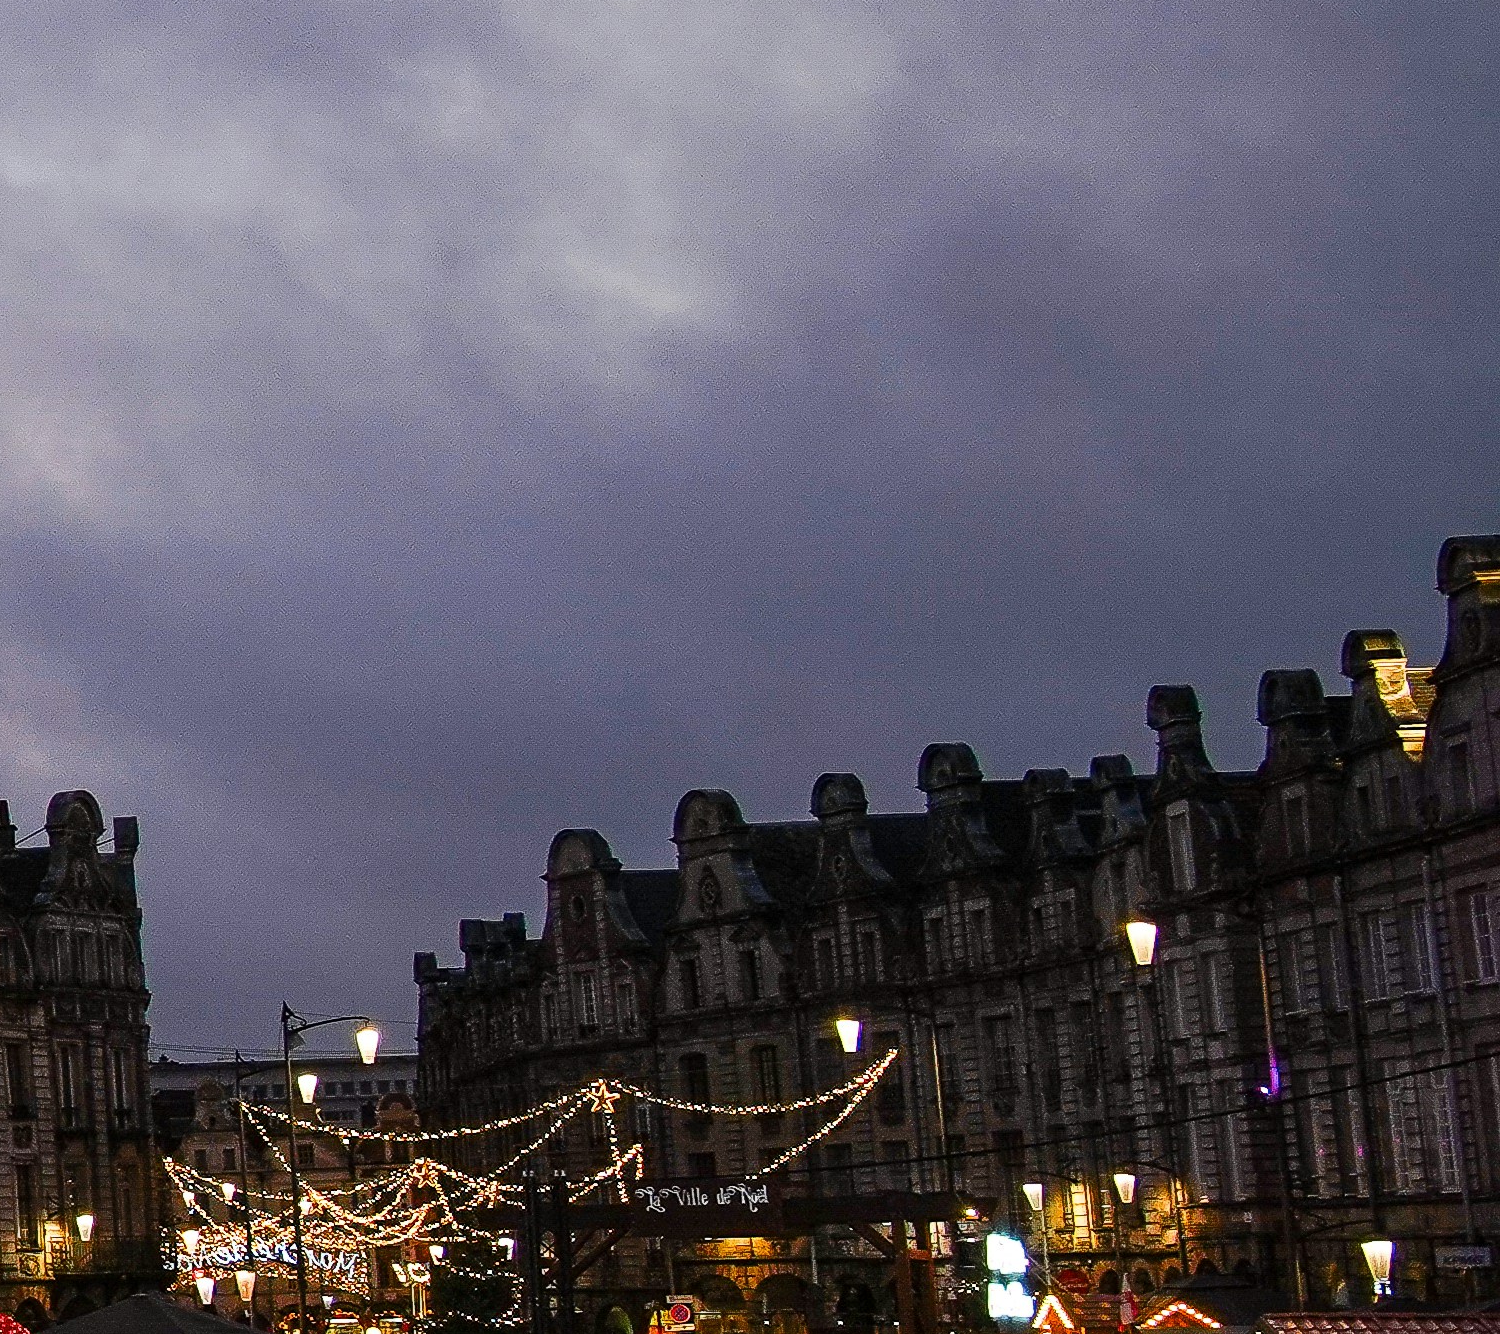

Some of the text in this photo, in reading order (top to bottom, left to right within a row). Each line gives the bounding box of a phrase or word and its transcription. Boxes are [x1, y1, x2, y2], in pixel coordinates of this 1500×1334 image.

[635, 1183, 769, 1213] La Ville de Noël
